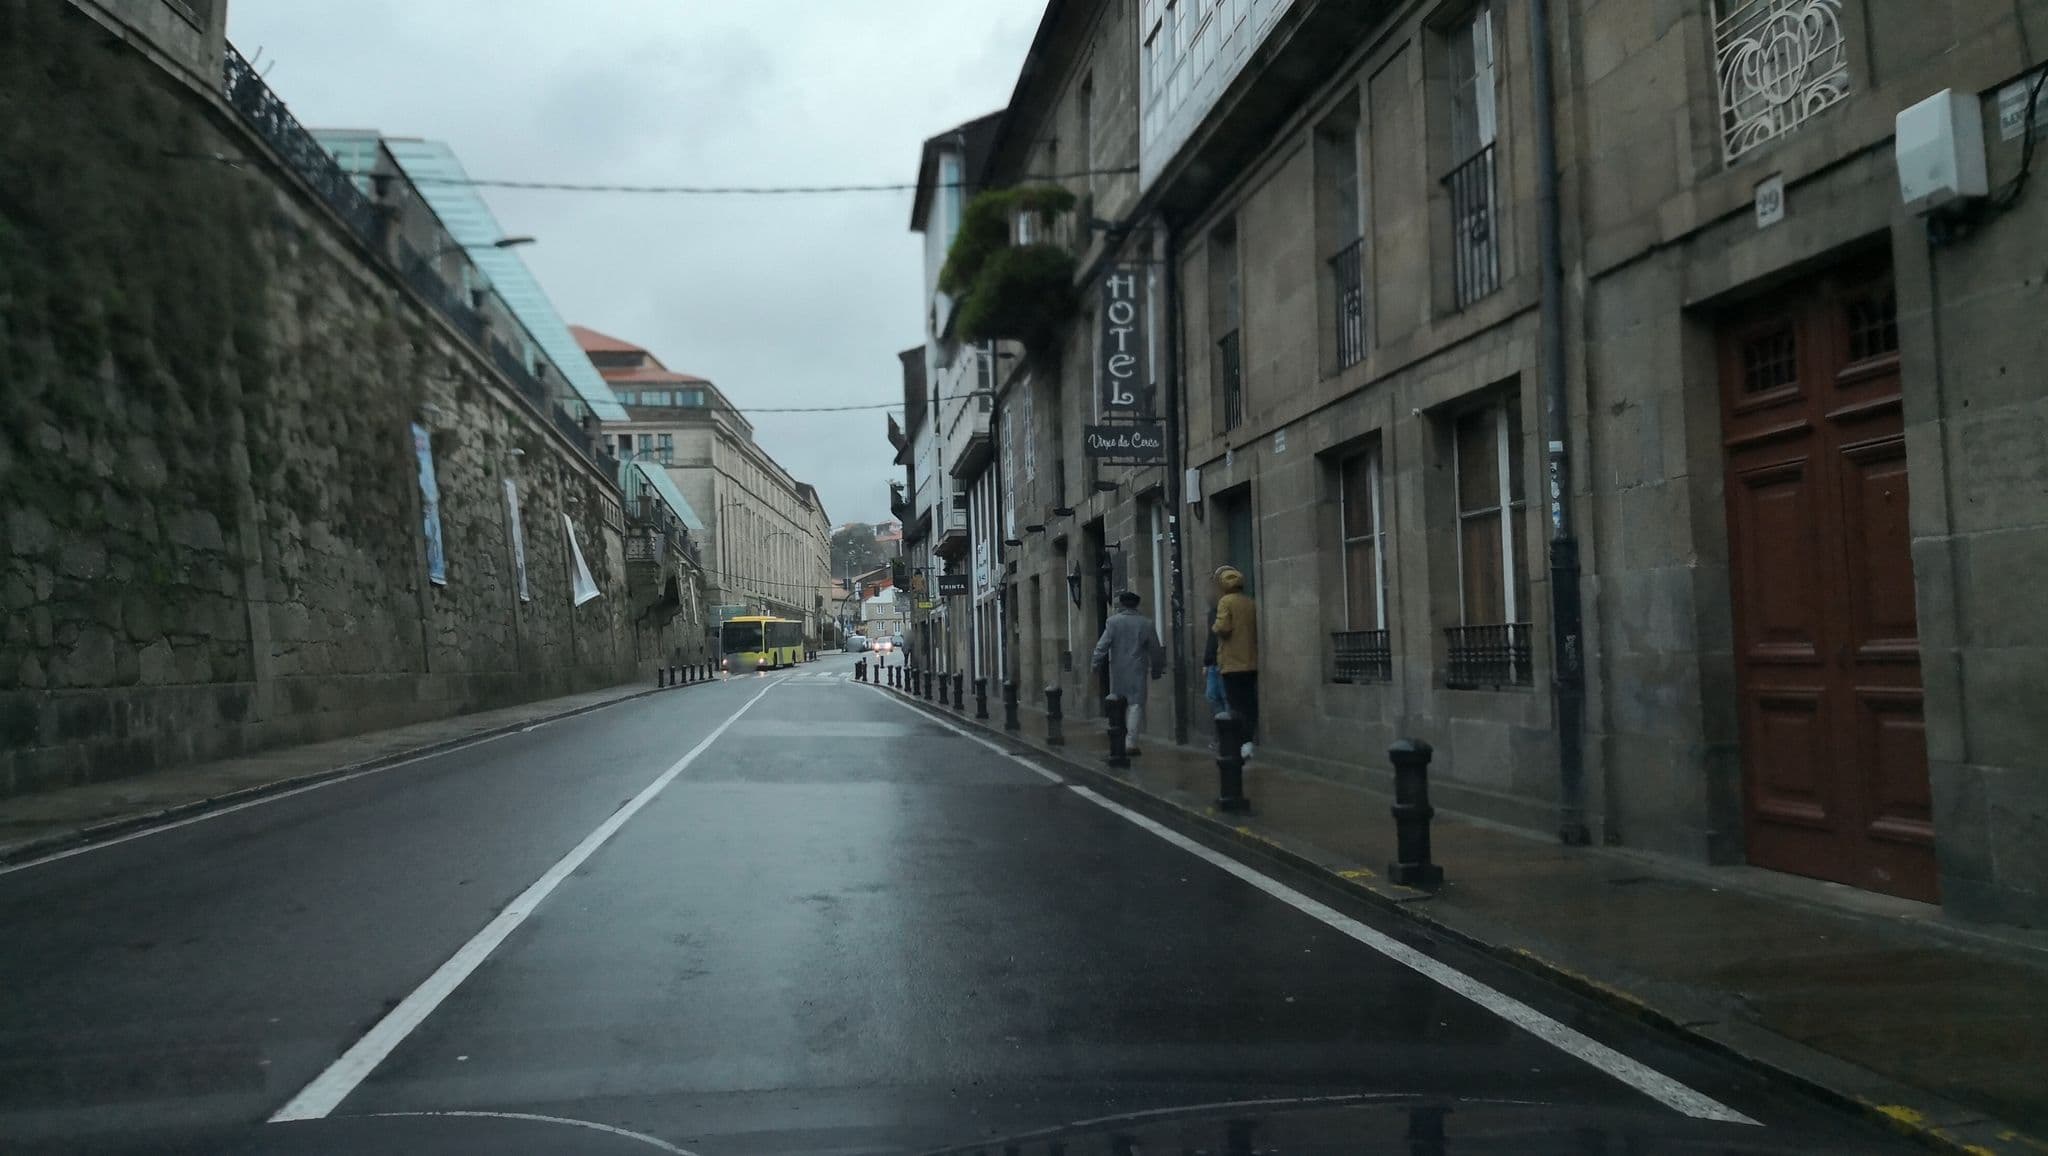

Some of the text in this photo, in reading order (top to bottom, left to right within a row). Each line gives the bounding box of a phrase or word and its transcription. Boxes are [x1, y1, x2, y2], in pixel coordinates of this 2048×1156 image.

[1106, 275, 1136, 405] HOTEL
[1118, 434, 1130, 448] da
[1131, 432, 1160, 448] Cerca
